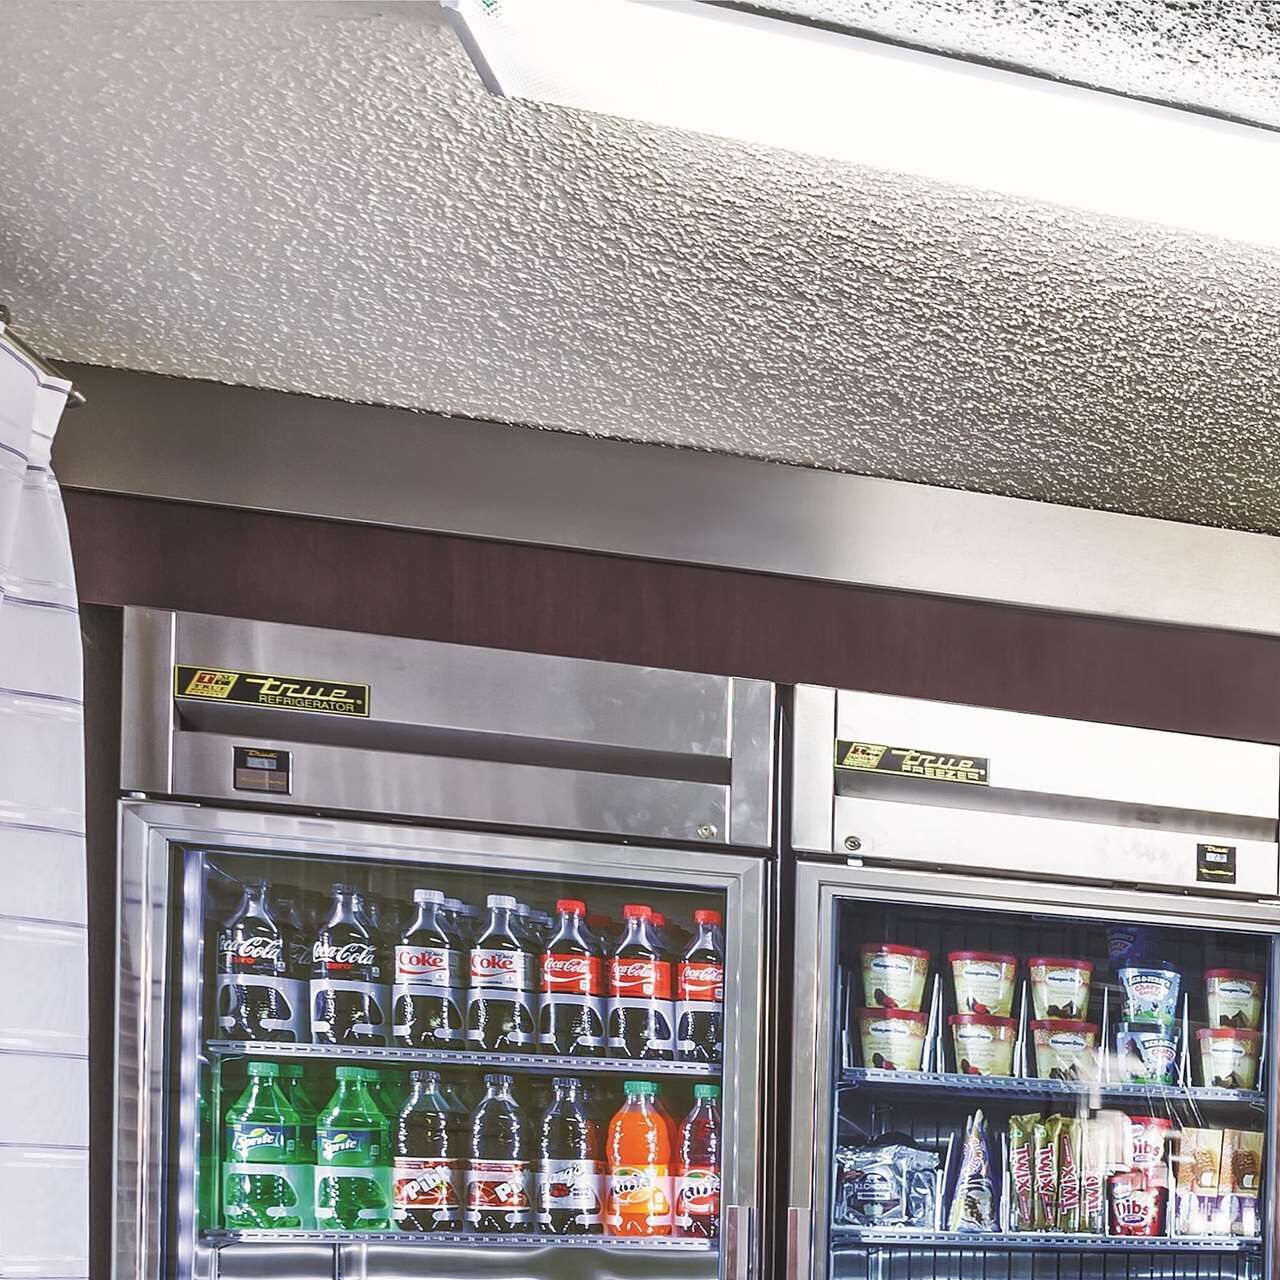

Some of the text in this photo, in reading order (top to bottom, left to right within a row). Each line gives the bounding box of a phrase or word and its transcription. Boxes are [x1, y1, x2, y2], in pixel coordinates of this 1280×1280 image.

[246, 677, 354, 703] true
[258, 694, 354, 713] REFRIGERATOR
[892, 749, 980, 773] true
[901, 764, 979, 780] FREEZER
[399, 950, 444, 968] Coke
[470, 952, 514, 970] Coke
[236, 1134, 276, 1151] Sprite
[1013, 1142, 1033, 1194] TWIX
[1037, 1142, 1057, 1195] TWIX
[1060, 1164, 1082, 1215] TWIX
[1113, 1198, 1151, 1217] Dibs
